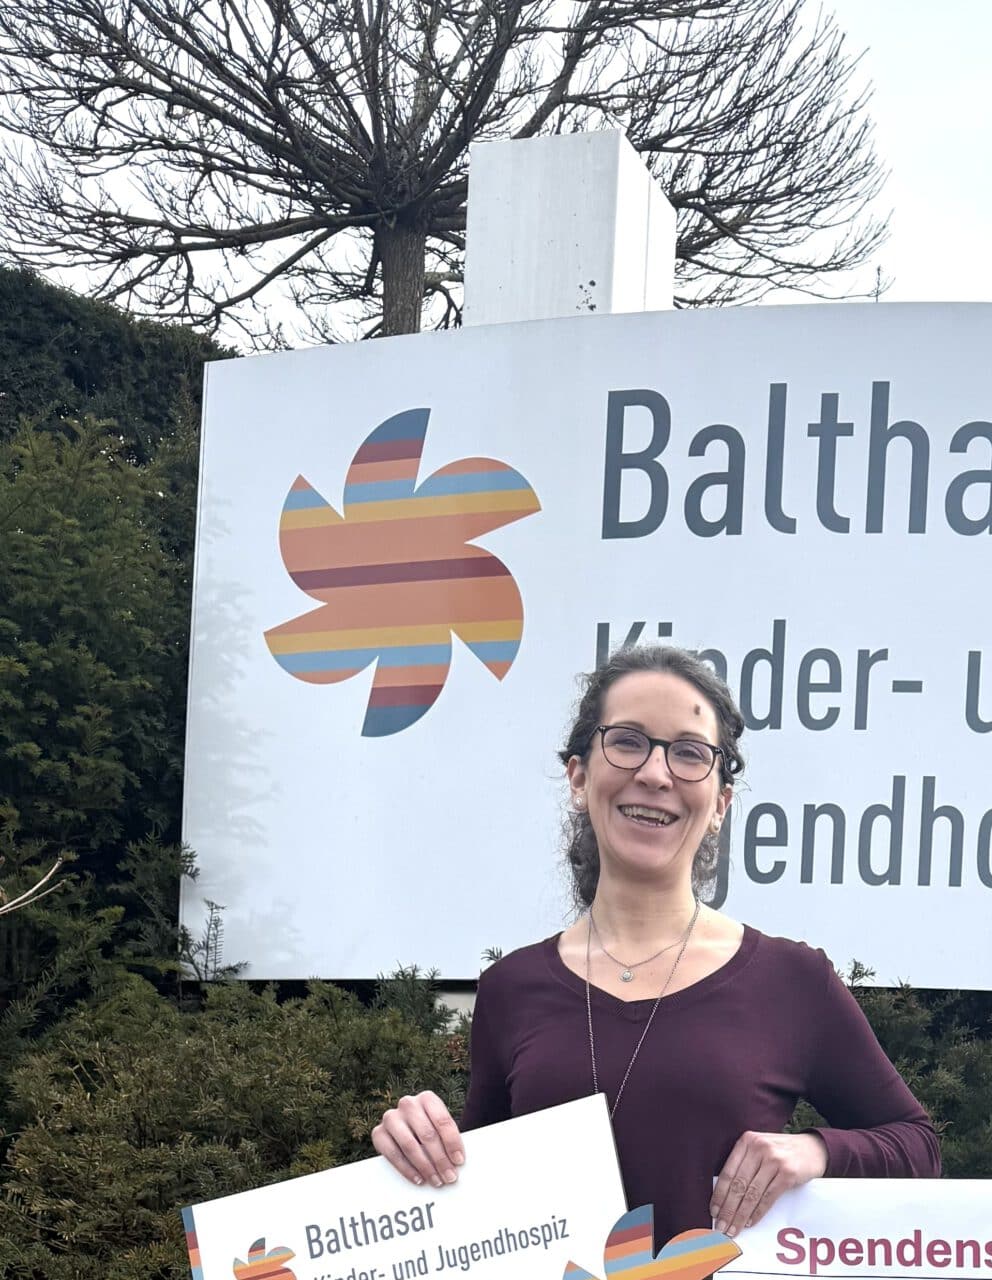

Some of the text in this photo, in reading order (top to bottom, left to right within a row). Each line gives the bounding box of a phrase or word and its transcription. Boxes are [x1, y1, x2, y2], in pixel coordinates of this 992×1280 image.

[595, 619, 924, 732] der-
[305, 1201, 436, 1261] Balthasar
[436, 1215, 571, 1272] Jugendhospiz
